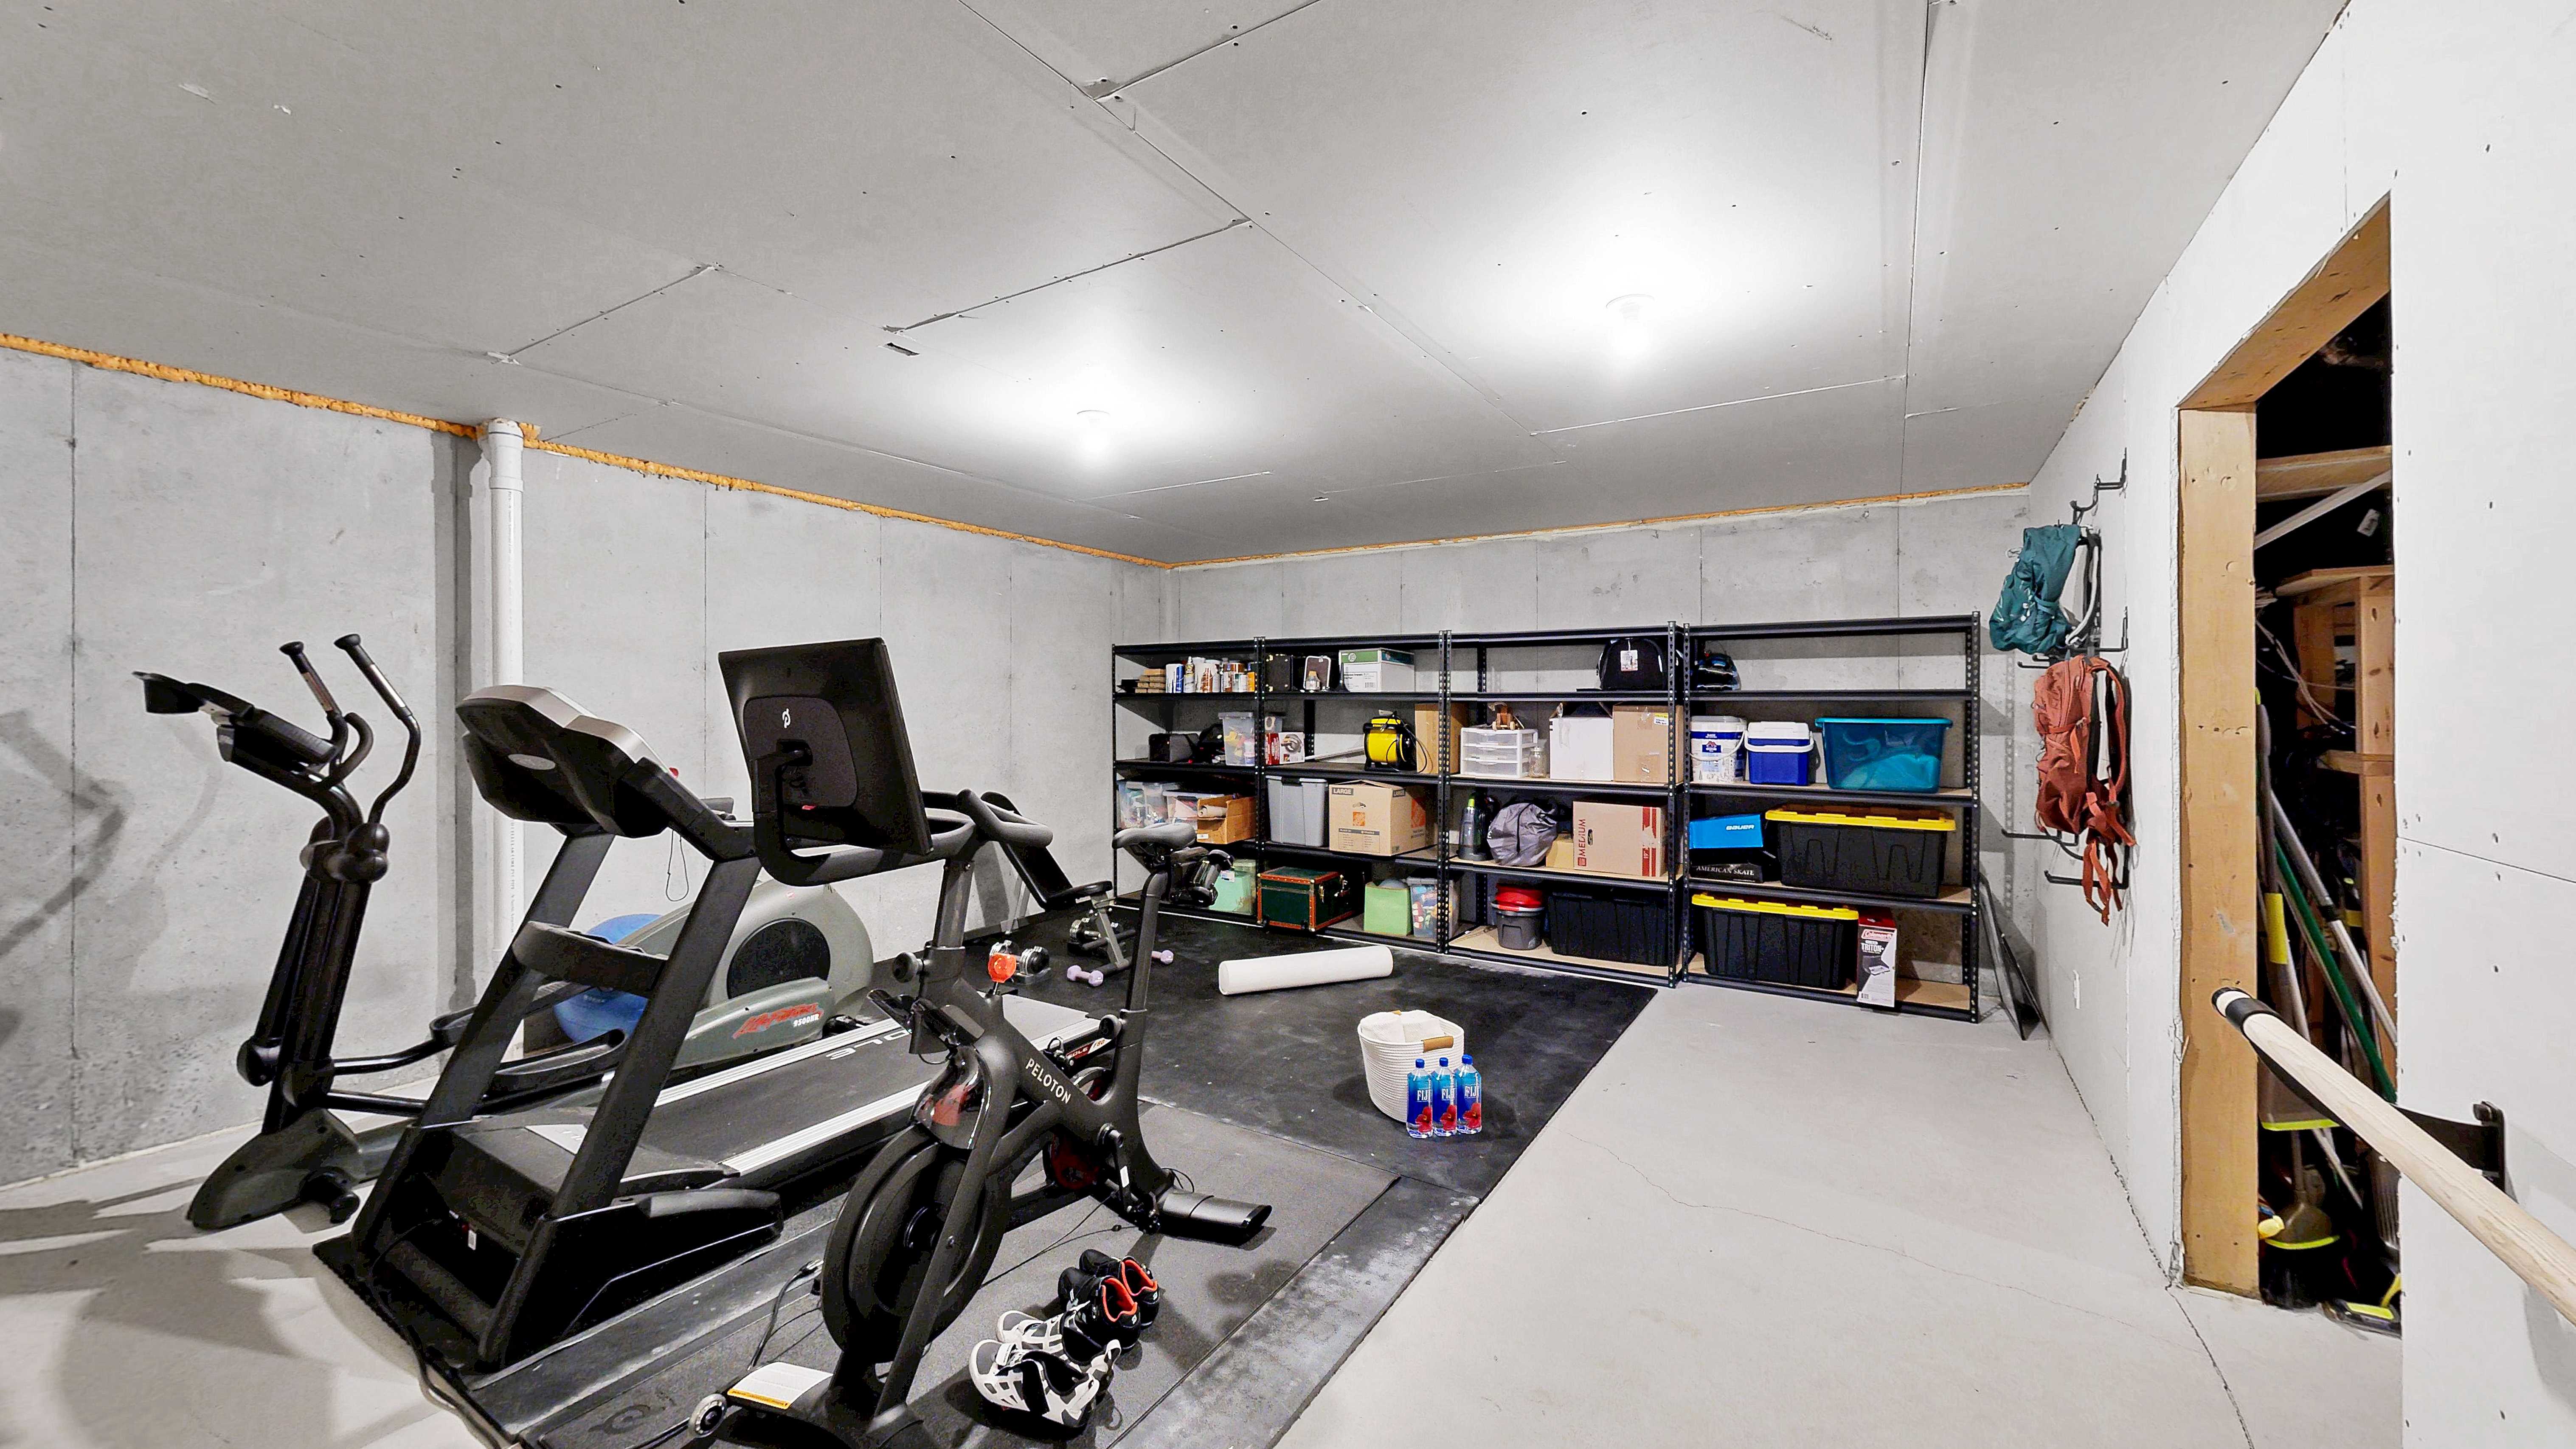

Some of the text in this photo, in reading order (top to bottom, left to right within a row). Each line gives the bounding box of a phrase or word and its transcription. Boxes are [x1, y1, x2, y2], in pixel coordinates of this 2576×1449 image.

[1696, 866, 1732, 874] AMERICAN
[793, 1013, 819, 1027] 9500HR
[1025, 1058, 1071, 1104] PELOTON
